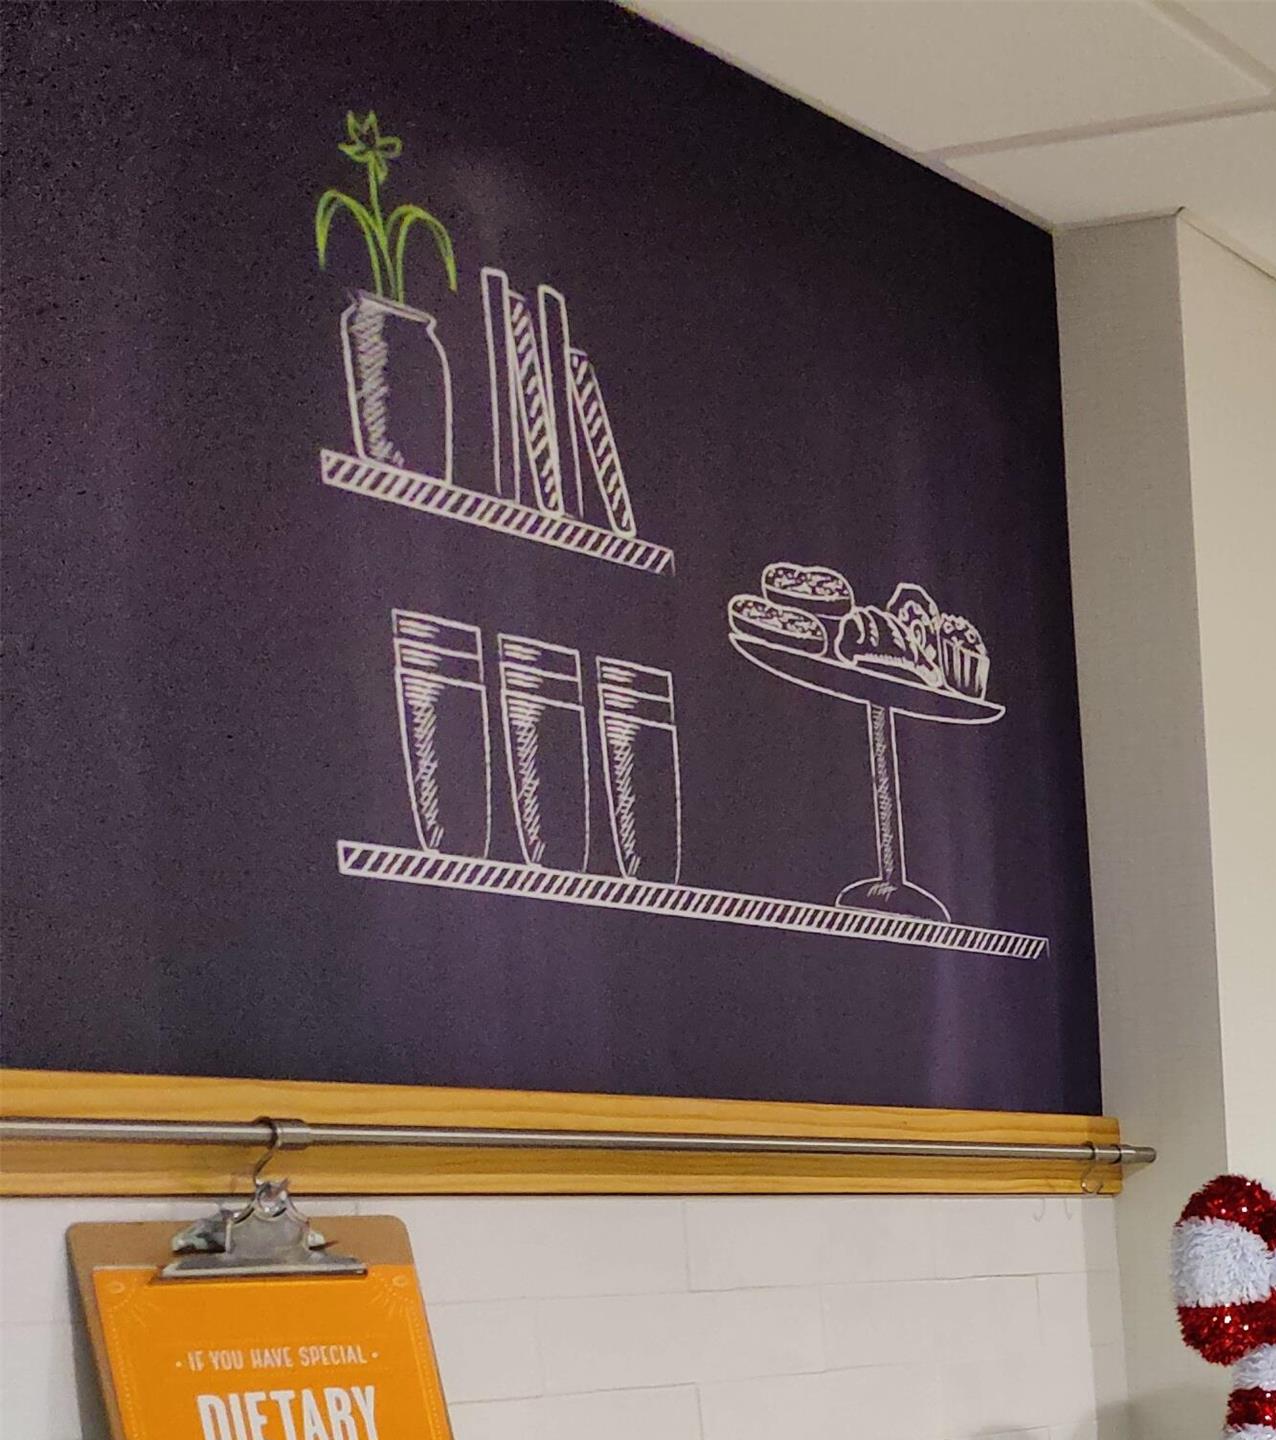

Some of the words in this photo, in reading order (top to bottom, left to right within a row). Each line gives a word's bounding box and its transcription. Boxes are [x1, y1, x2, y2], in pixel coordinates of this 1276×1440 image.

[188, 1351, 205, 1371] IF
[209, 1349, 244, 1370] YOU
[250, 1347, 293, 1368] HAVE
[299, 1345, 367, 1366] SPECIAL
